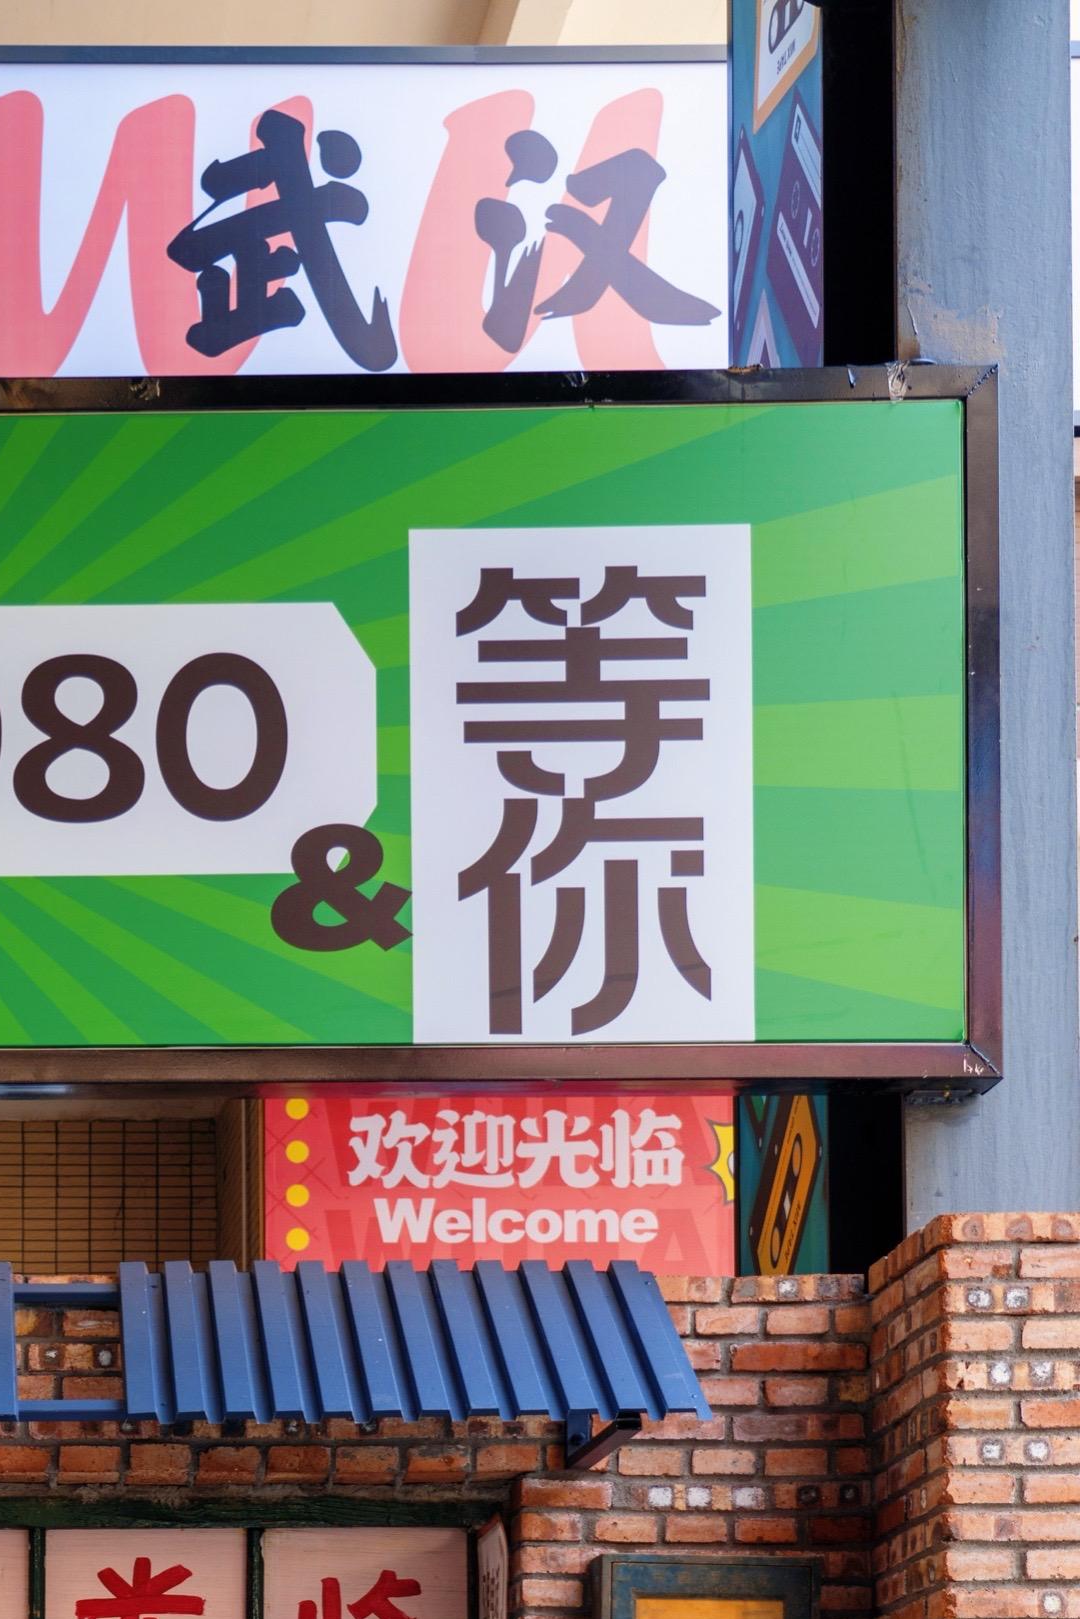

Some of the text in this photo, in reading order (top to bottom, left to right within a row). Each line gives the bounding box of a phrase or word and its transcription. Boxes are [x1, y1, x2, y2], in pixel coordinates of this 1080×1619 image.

[165, 108, 723, 372] 武汉
[455, 565, 712, 1037] 等你
[347, 1108, 686, 1189] 欢迎光临
[373, 1197, 660, 1244] Welcome
